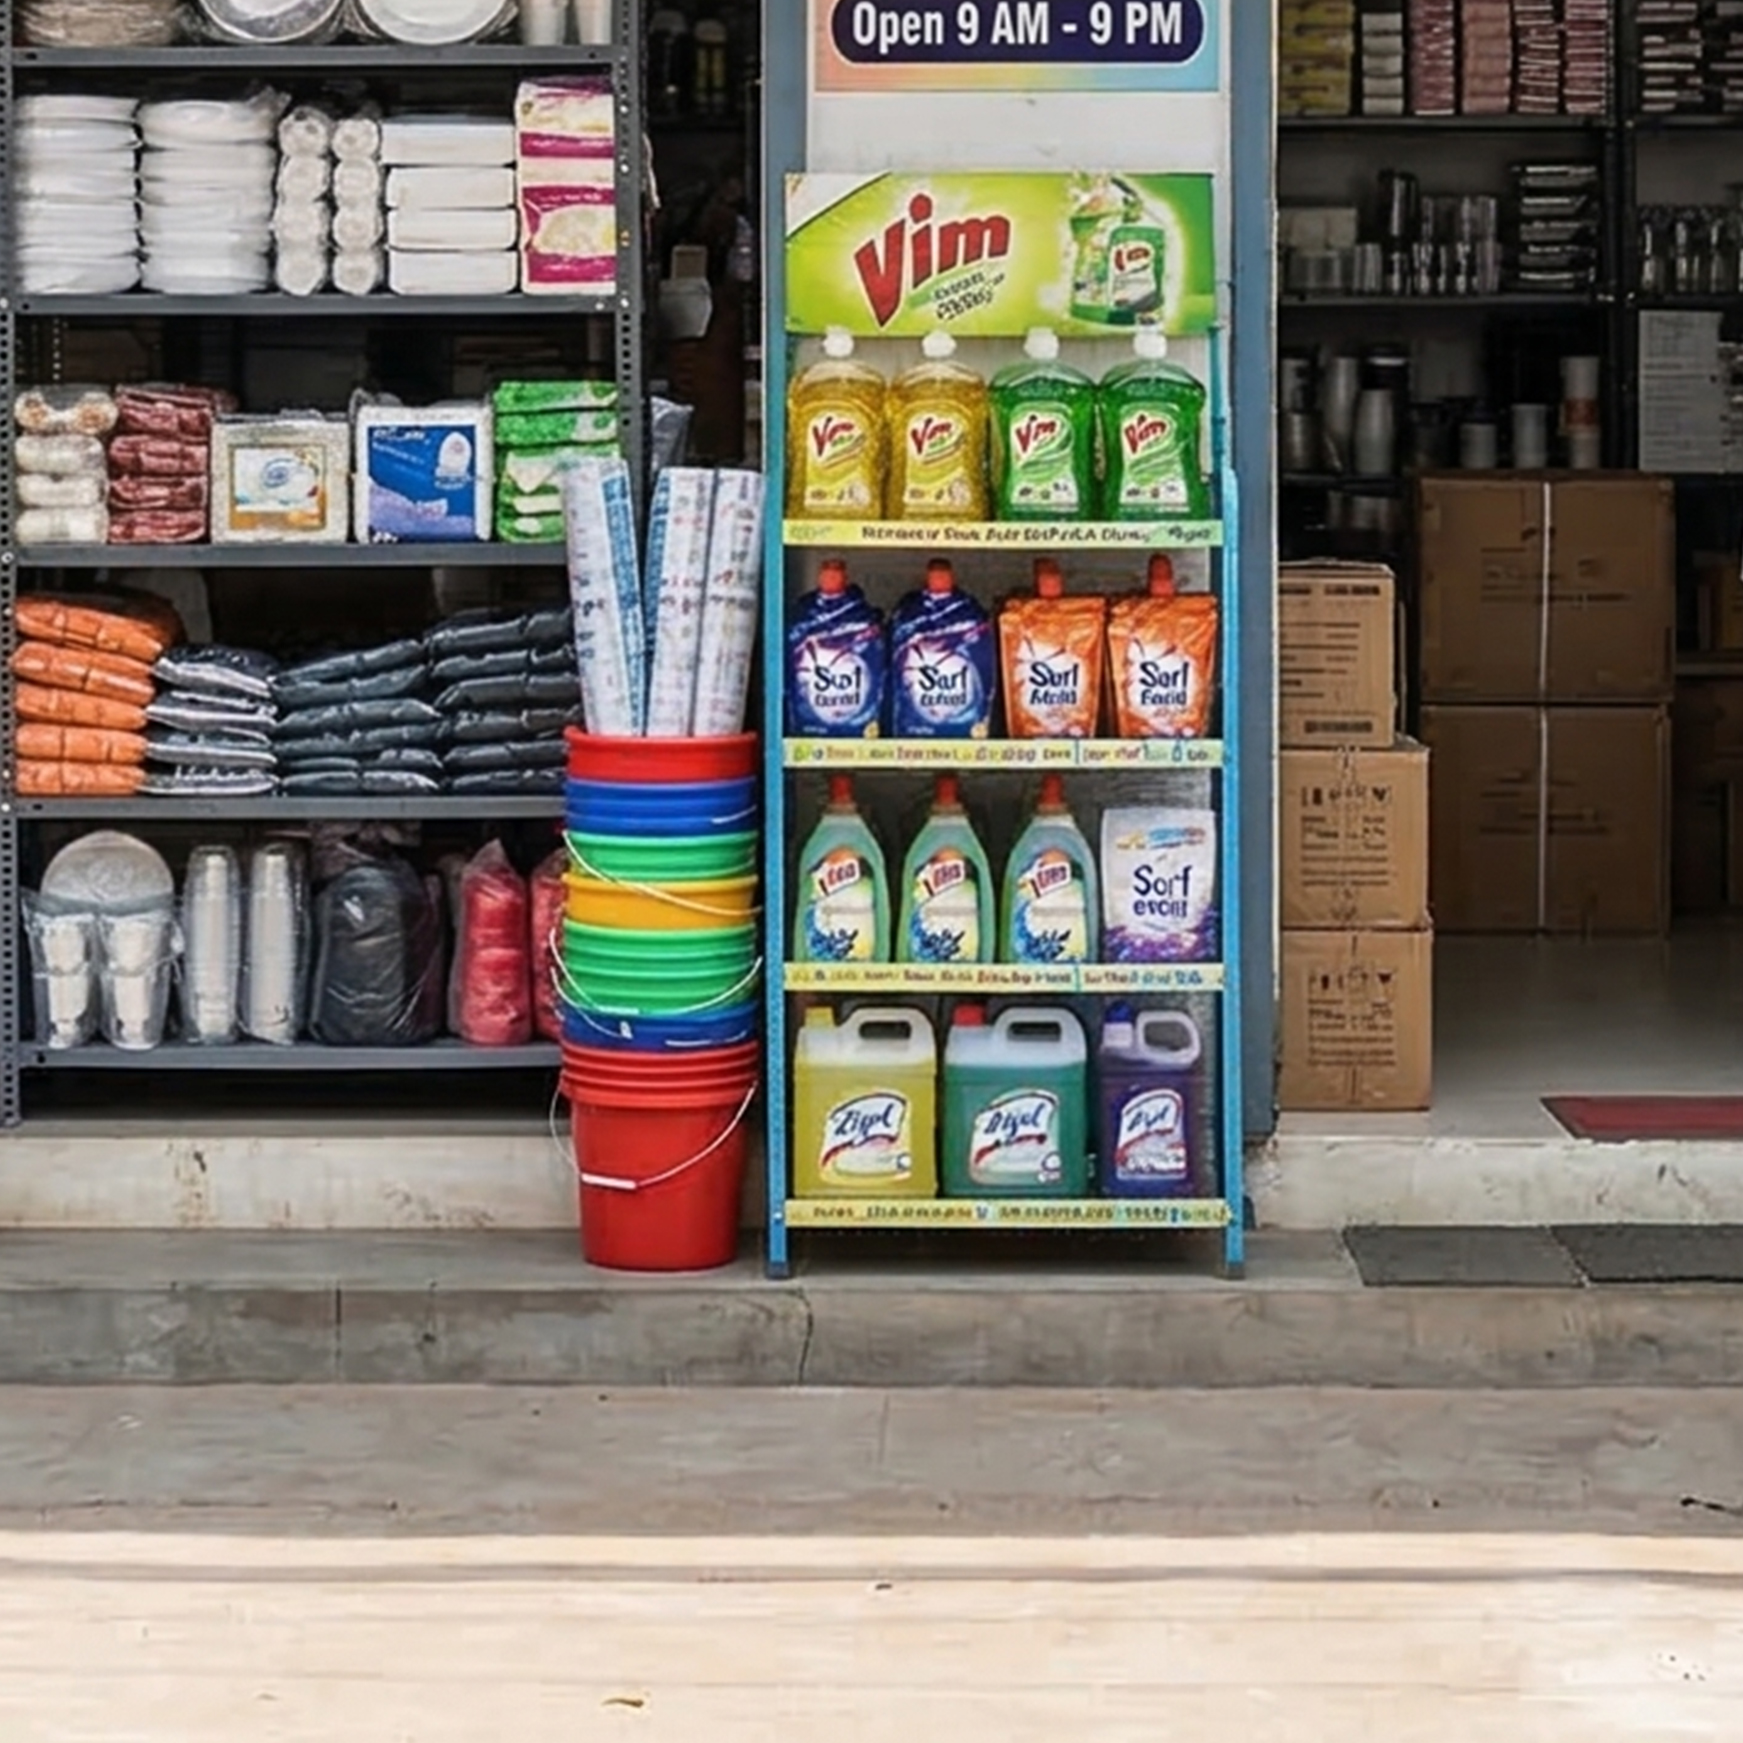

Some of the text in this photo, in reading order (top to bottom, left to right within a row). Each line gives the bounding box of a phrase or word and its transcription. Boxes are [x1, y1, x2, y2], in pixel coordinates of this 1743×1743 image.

[853, 1, 944, 55] Open
[957, 1, 979, 45] 9
[991, 1, 1049, 45] AM
[1090, 1, 1112, 45] 9
[1125, 1, 1182, 45] PM
[855, 193, 1011, 328] Vim
